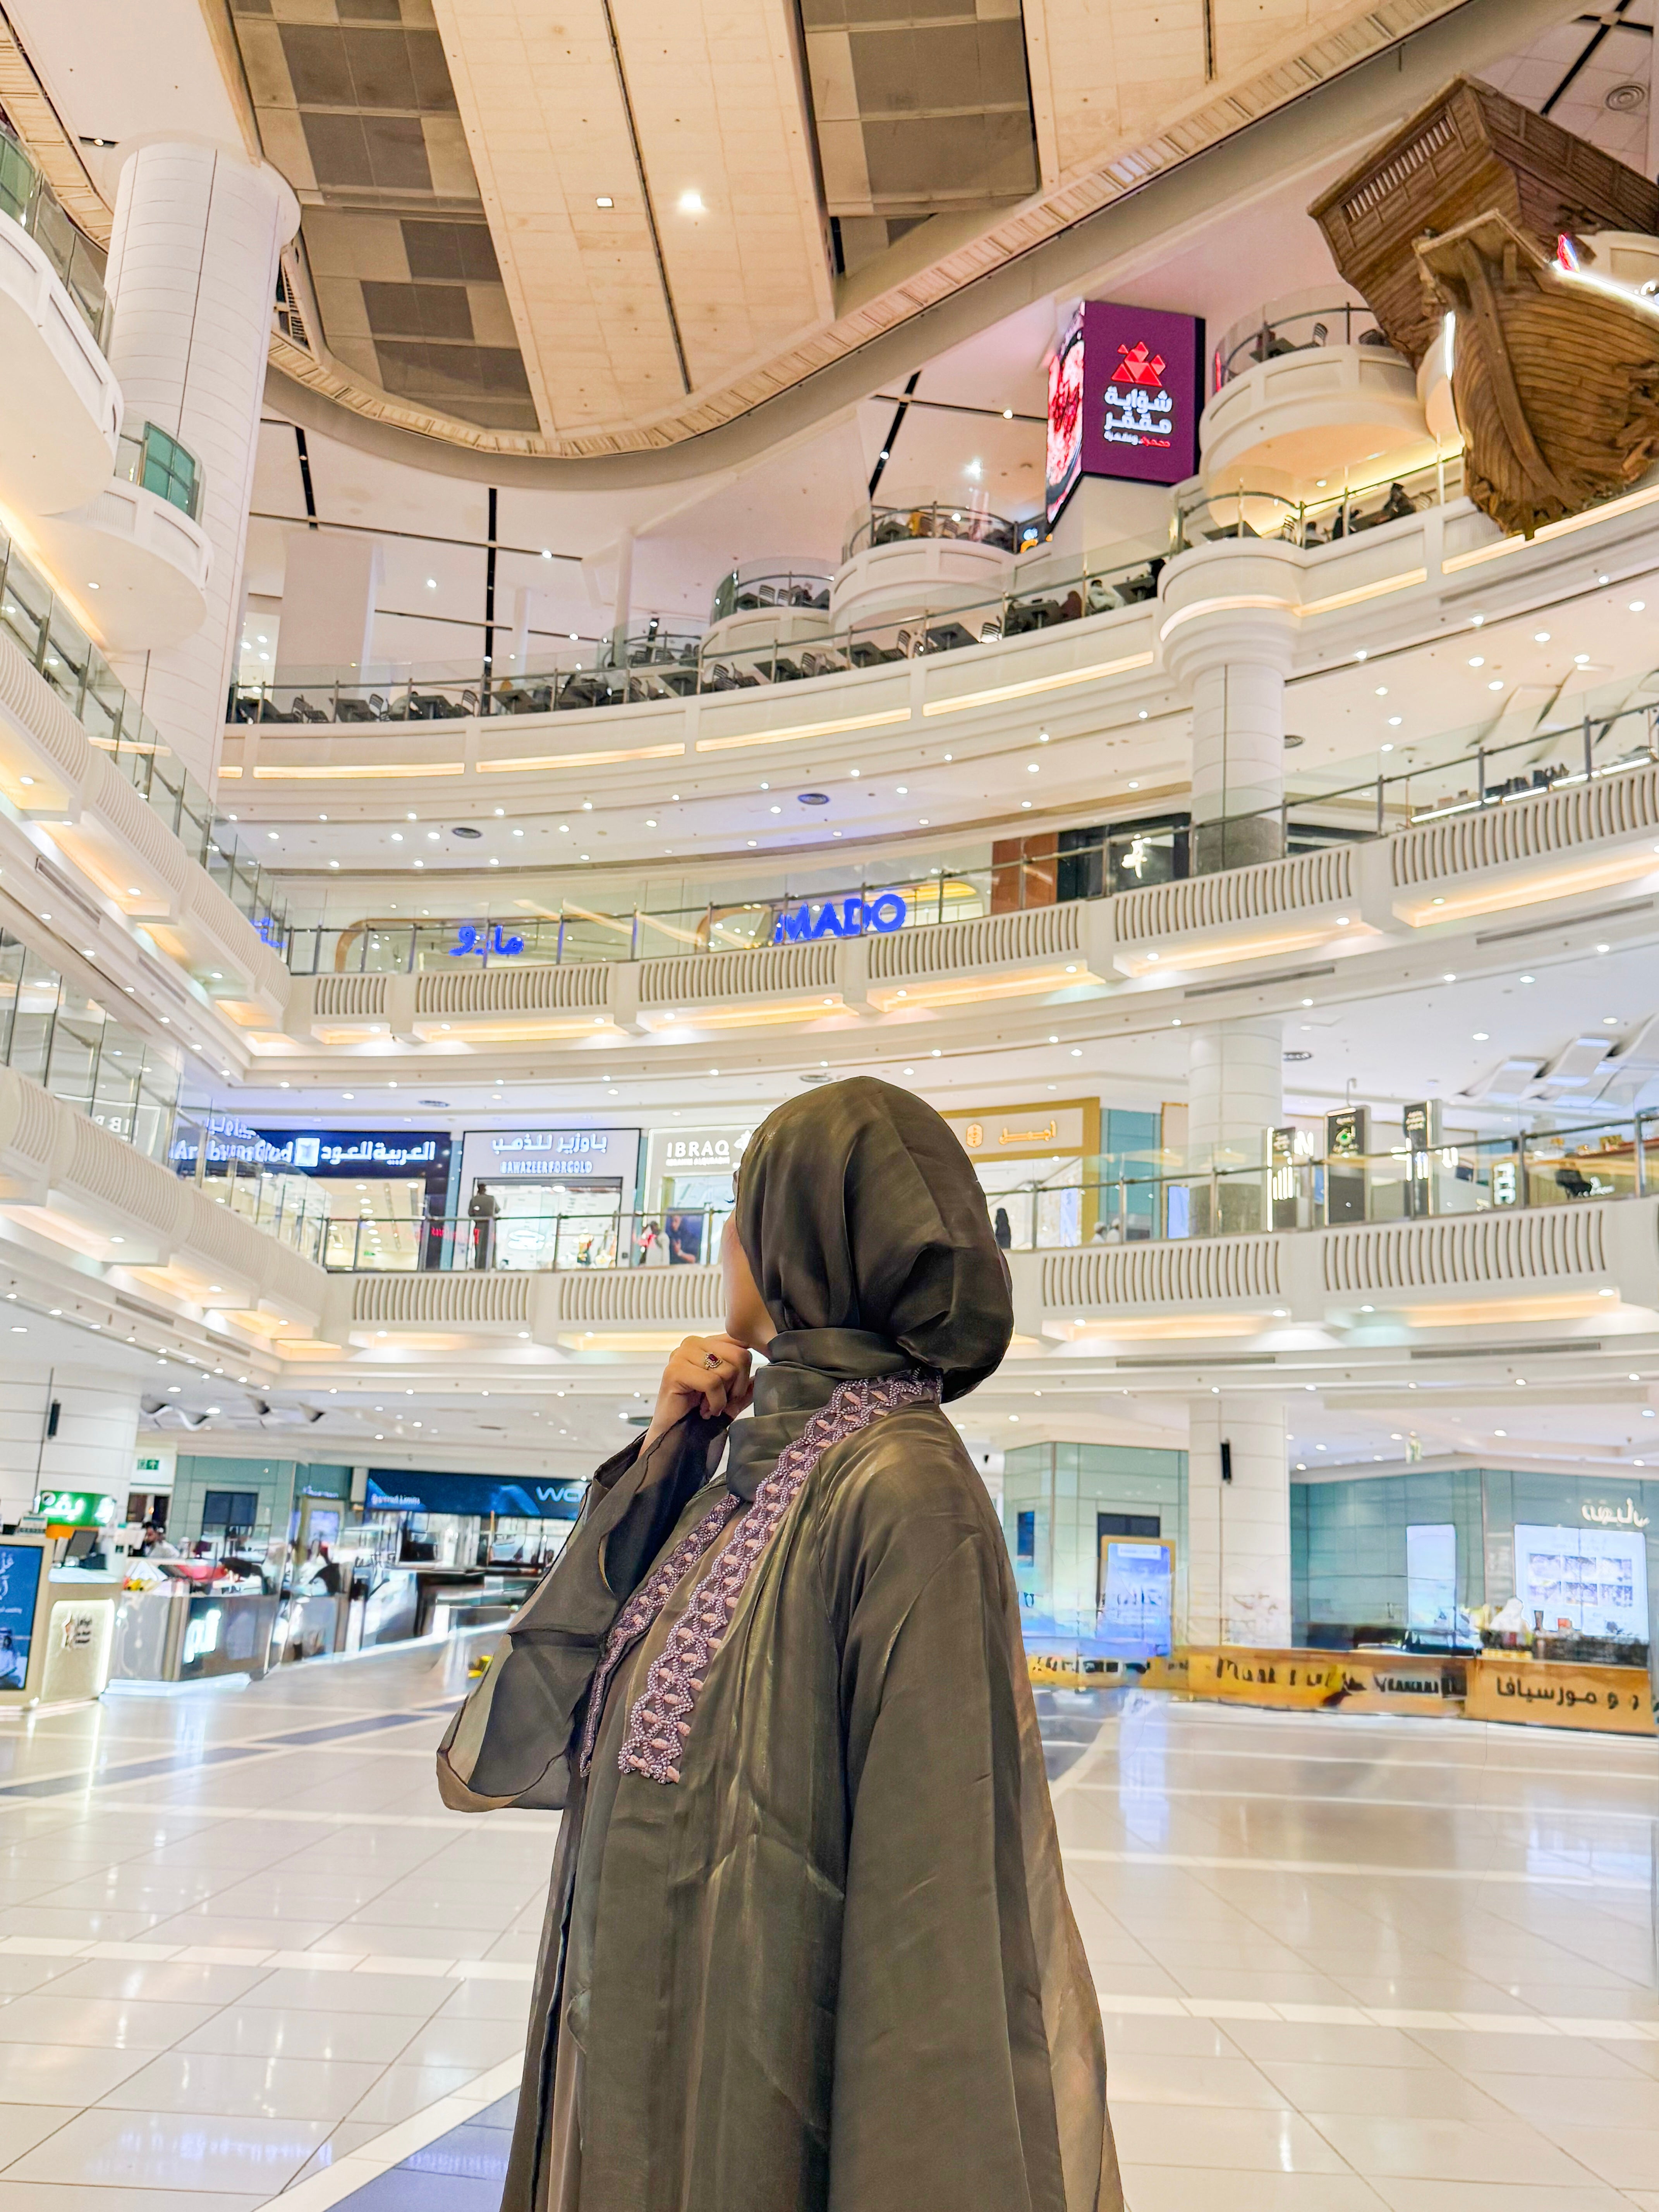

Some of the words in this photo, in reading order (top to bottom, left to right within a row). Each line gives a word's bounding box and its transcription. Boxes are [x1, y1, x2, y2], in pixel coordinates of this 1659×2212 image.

[774, 894, 907, 943] MADO
[321, 1141, 373, 1165] للعود
[374, 1141, 436, 1166] العربية
[667, 1140, 730, 1158] IBRAQ
